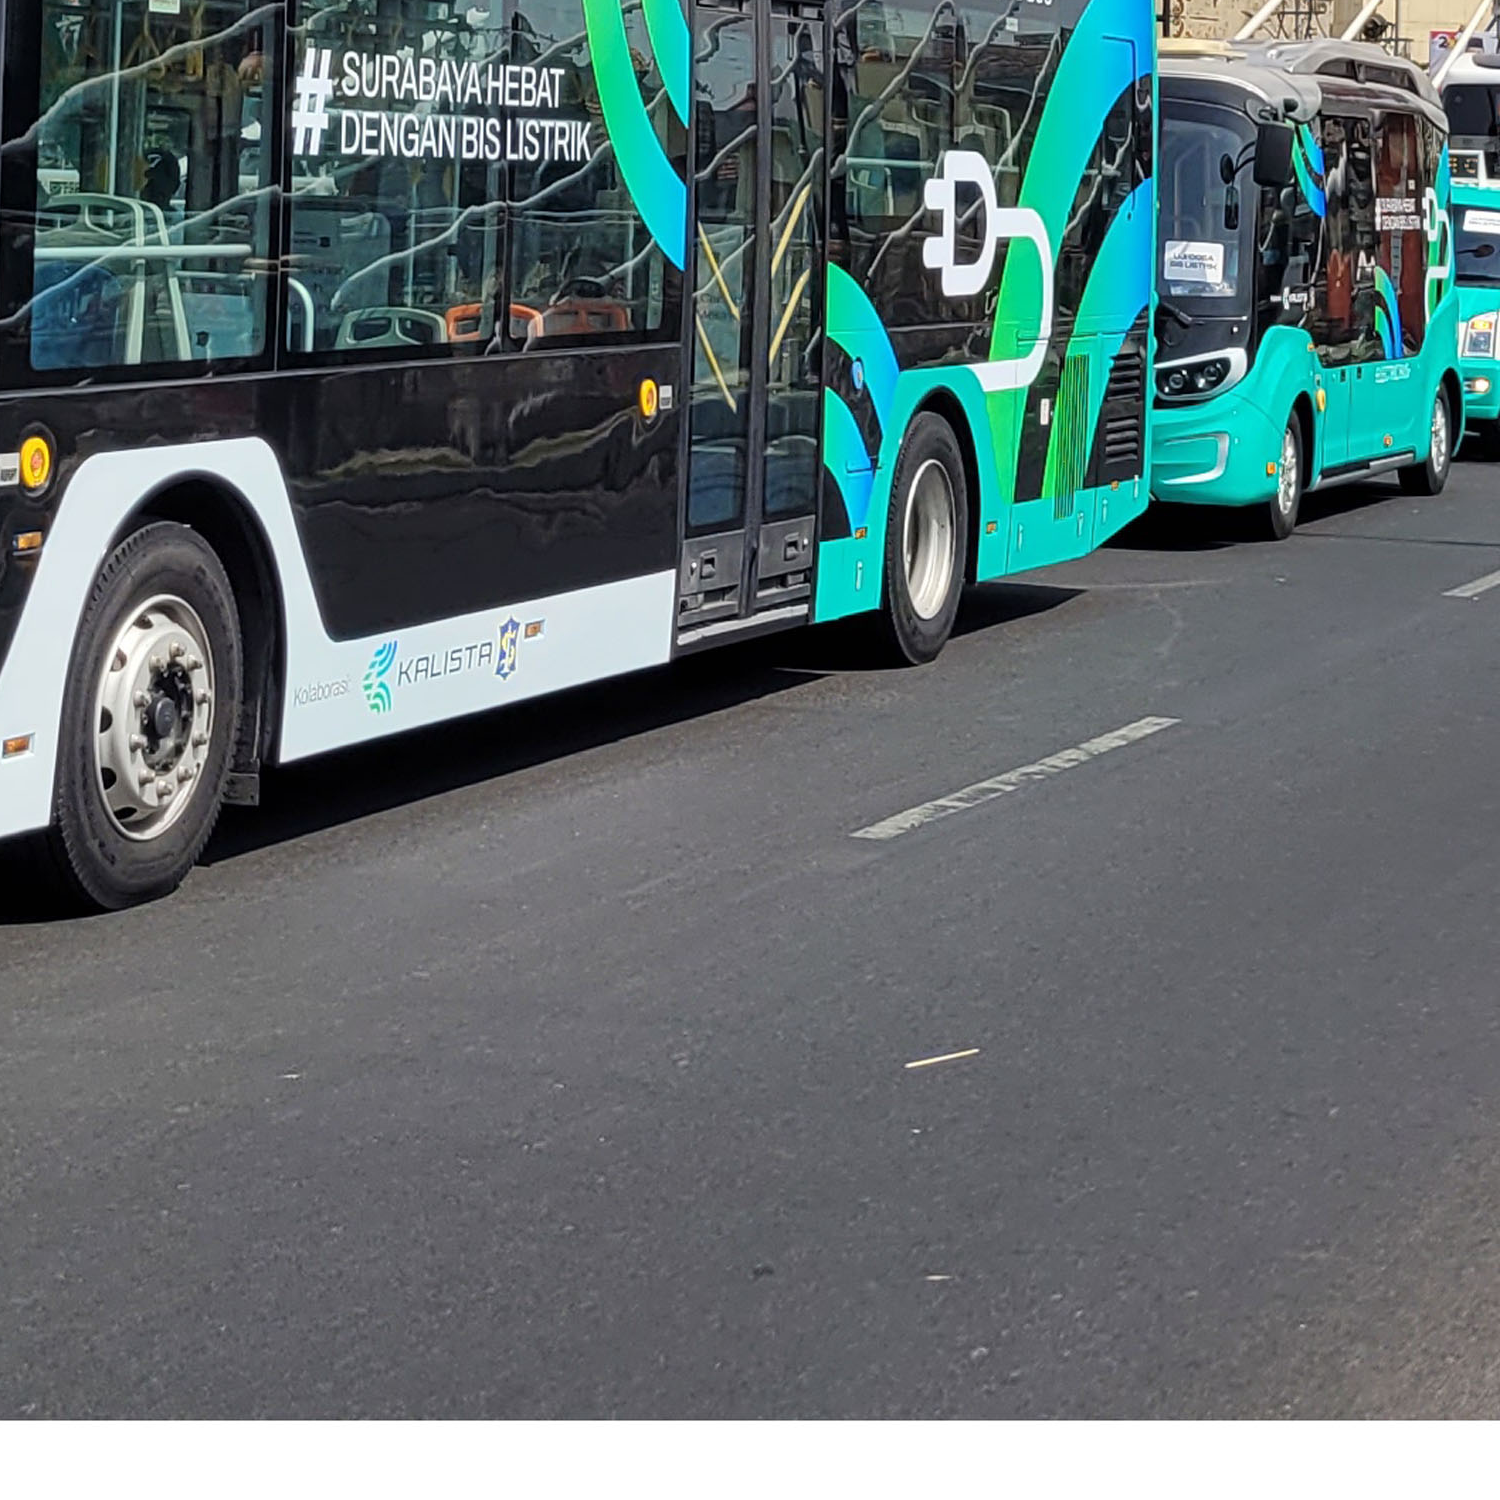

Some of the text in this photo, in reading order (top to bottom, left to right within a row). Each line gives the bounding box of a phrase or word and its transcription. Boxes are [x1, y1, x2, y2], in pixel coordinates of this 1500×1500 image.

[341, 50, 565, 108] SURABAYA HEBAT
[340, 108, 592, 162] DENGAN BIS LISTRIK
[397, 641, 492, 687] KALISTA
